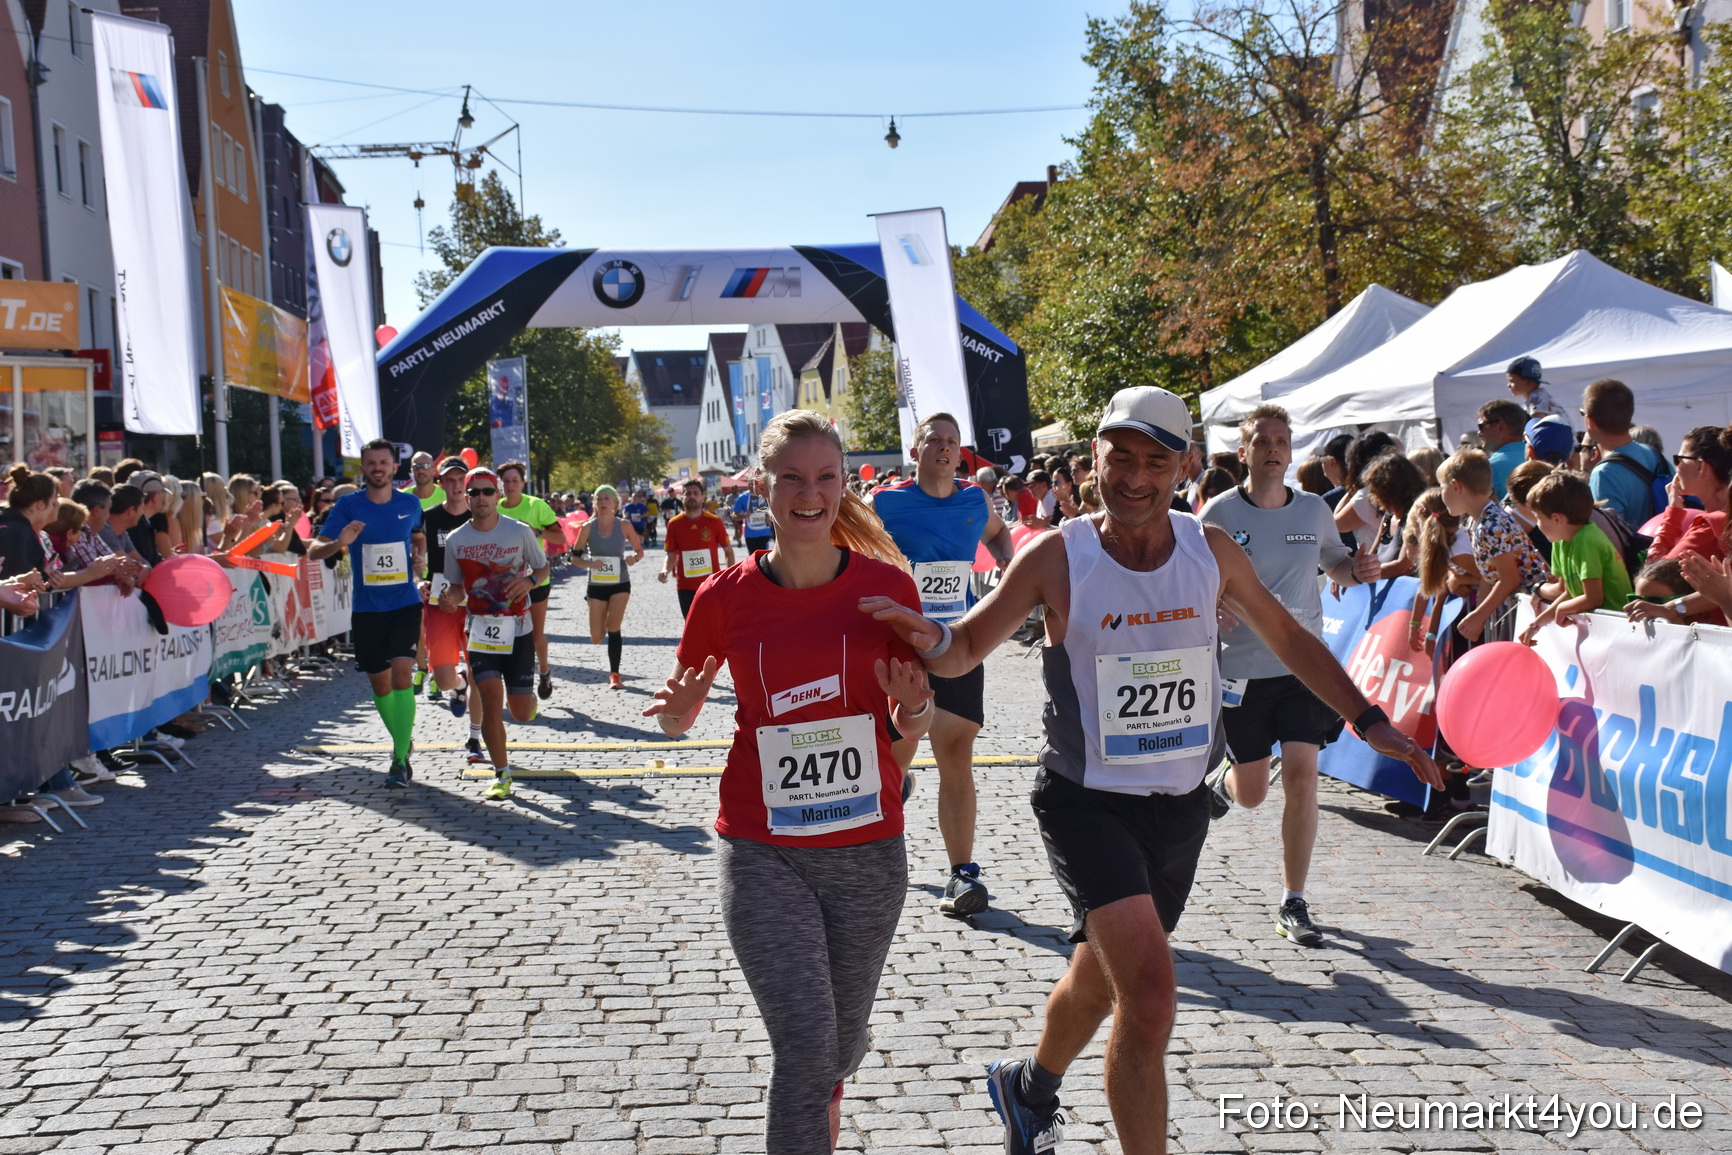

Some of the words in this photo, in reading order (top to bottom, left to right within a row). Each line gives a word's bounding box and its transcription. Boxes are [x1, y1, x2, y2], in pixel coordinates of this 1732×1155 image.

[389, 347, 435, 378] PARTL
[432, 300, 506, 352] NEUMARKT
[960, 332, 1004, 364] MARKT
[1285, 534, 1317, 542] BOCK
[457, 543, 497, 556] FINISHER
[495, 546, 519, 556] TEAM
[376, 555, 393, 568] 43
[689, 556, 705, 567] 338
[922, 576, 960, 594] 2252
[929, 604, 953, 612] Jochen
[1127, 607, 1200, 626] KLEBL
[485, 626, 500, 639] 42
[89, 648, 152, 683] RAILONE
[1132, 659, 1182, 675] BOCK
[0, 676, 58, 722] RAILO
[791, 687, 821, 704] DEHN
[1117, 678, 1196, 718] 2276
[1126, 722, 1151, 730] PARTL
[1152, 718, 1182, 728] Neumarkt
[791, 728, 843, 746] BOCK
[1138, 732, 1182, 751] Roland
[778, 747, 862, 790] 2470
[789, 793, 814, 801] PARTL
[815, 788, 849, 799] Neumarkt
[801, 805, 851, 823] Marina
